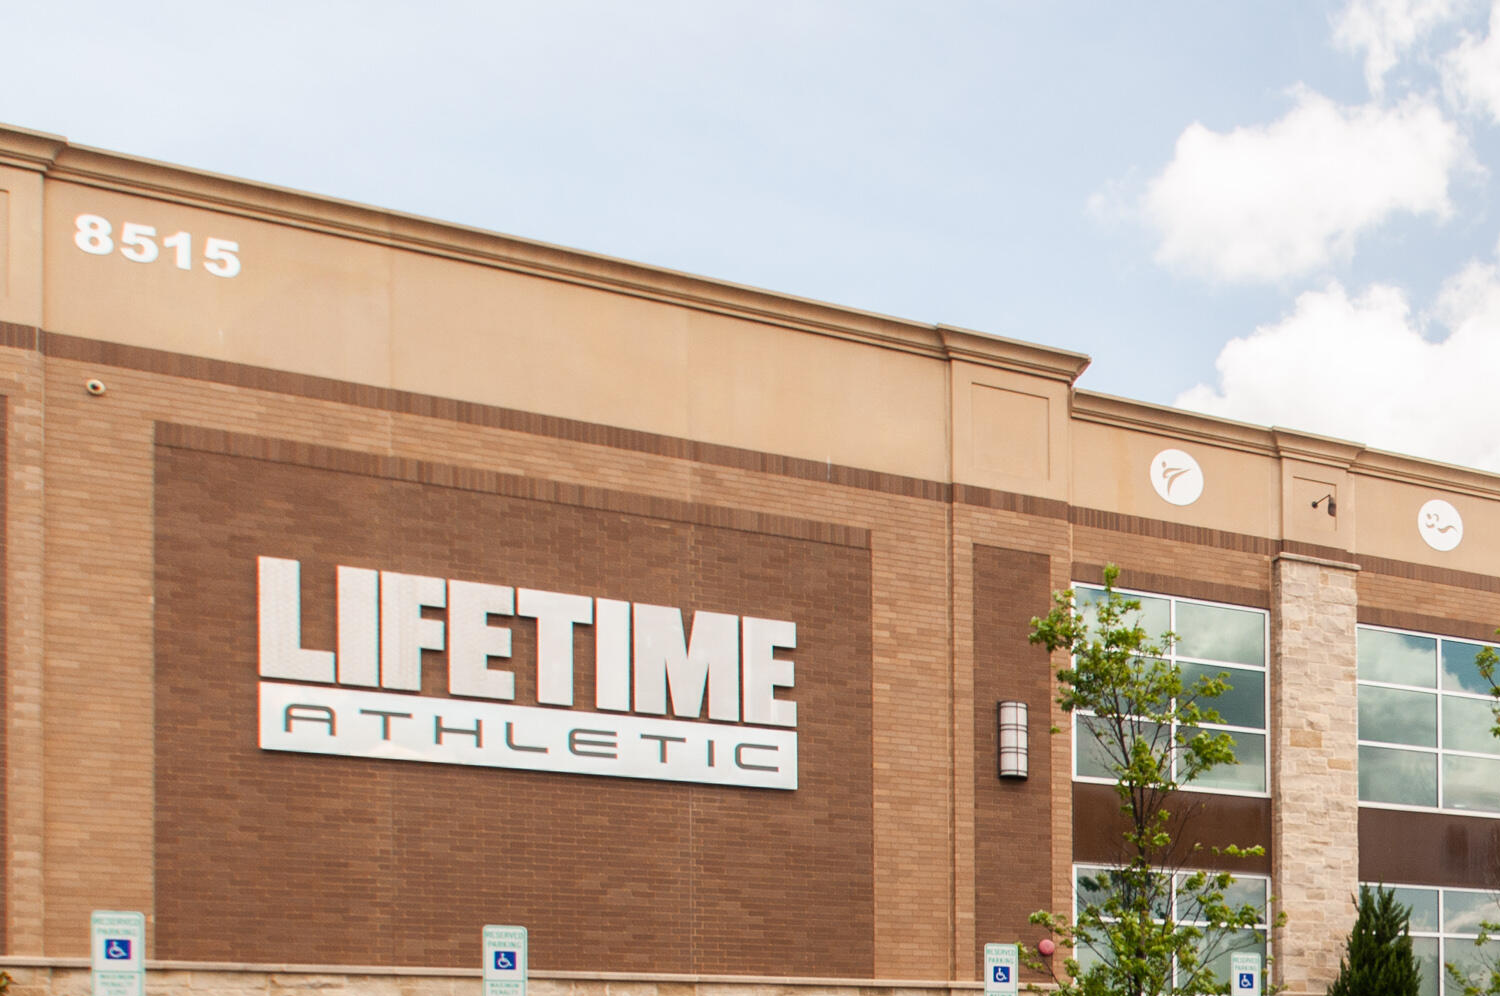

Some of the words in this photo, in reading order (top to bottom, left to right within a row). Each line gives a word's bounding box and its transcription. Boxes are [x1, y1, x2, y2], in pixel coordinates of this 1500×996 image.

[74, 214, 241, 278] 8515
[258, 556, 797, 727] LIFETIME
[284, 703, 779, 772] ATHLETIC
[96, 927, 136, 936] PARKING
[487, 940, 522, 949] PARKING
[986, 949, 1016, 957] RESERVED
[988, 957, 1014, 965] PARKING
